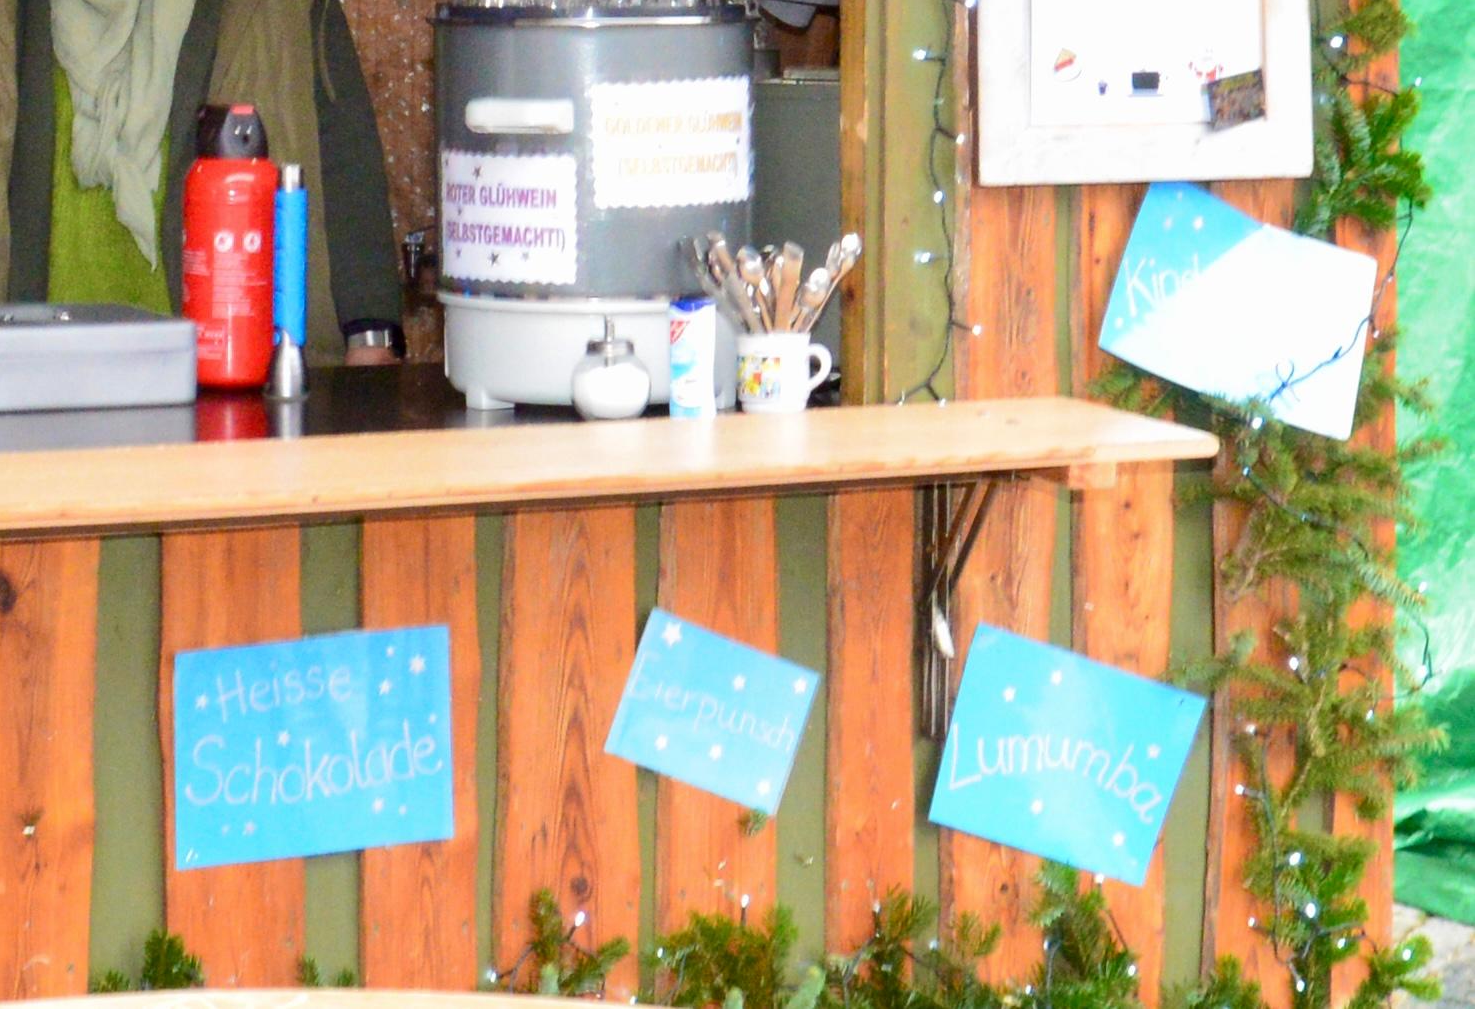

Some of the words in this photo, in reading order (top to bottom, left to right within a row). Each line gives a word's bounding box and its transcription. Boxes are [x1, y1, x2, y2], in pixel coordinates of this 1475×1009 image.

[479, 182, 557, 208] GLÜHWEIN
[216, 664, 352, 724] Heisse
[185, 717, 444, 806] Schokolade
[949, 722, 1163, 824] Lumumba
